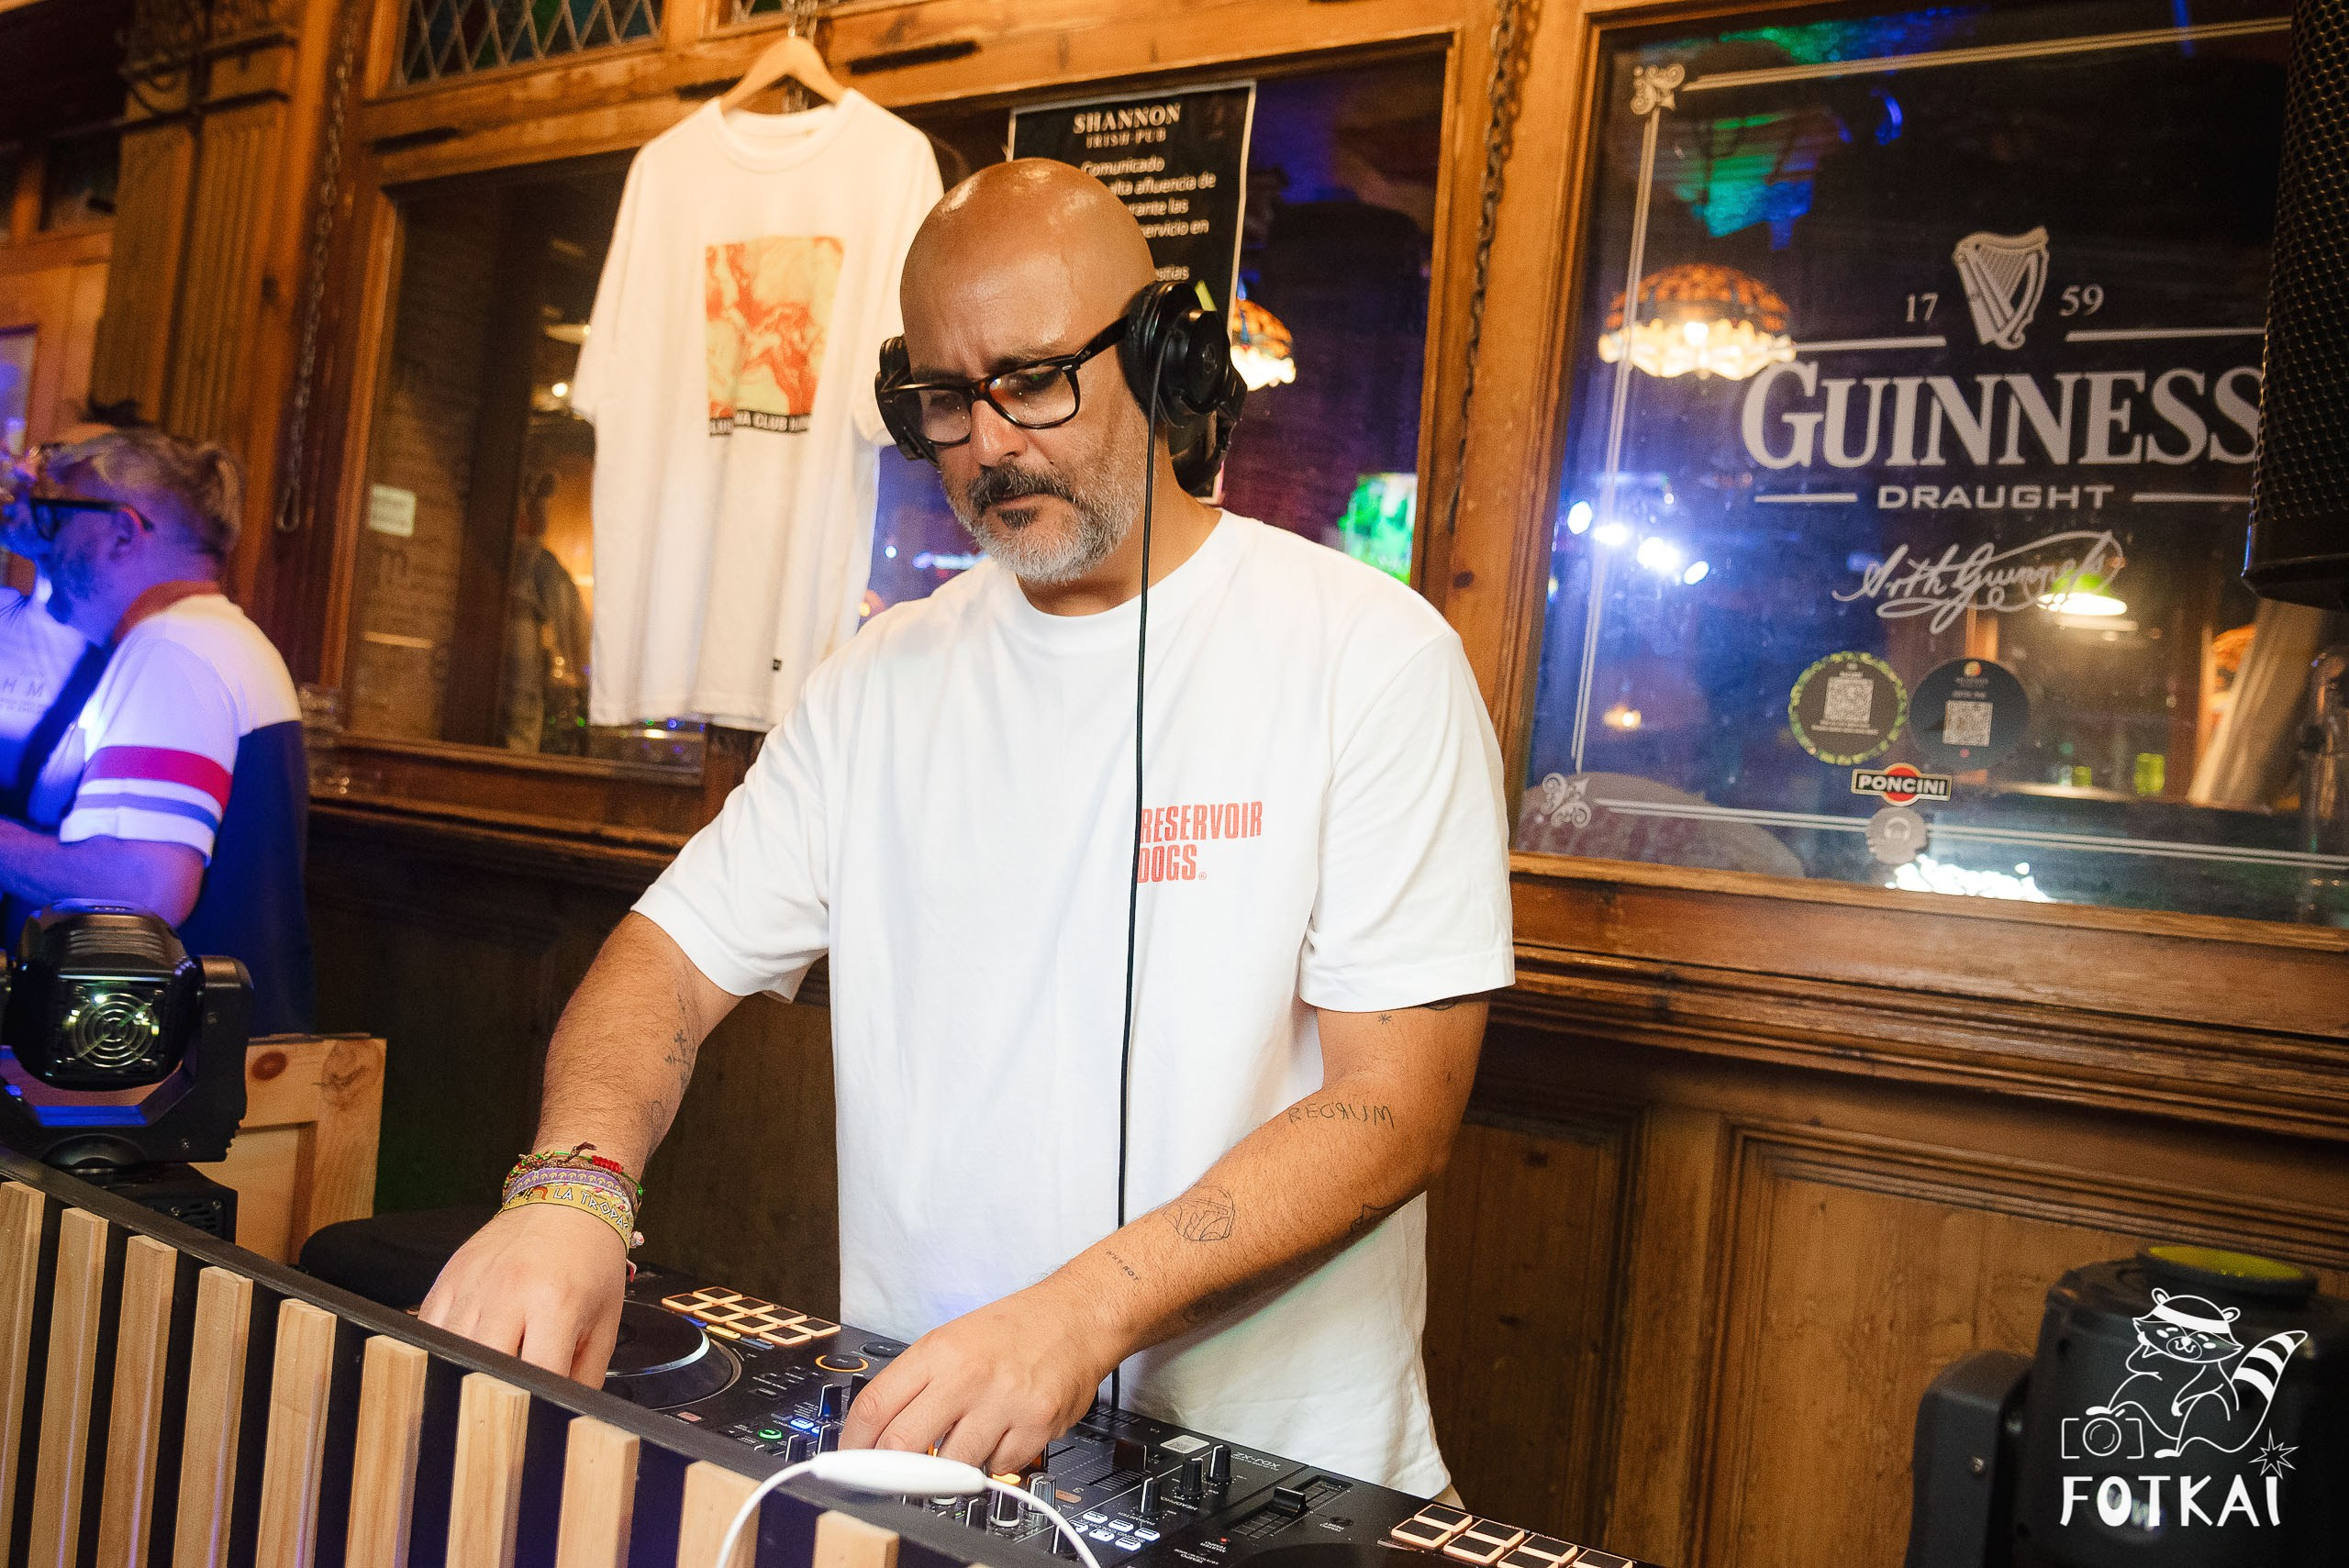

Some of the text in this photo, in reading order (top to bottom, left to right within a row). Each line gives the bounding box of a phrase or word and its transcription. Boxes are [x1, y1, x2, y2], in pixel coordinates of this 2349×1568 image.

[1073, 102, 1181, 134] SHANNON
[1085, 127, 1166, 149] IRISH PUB
[1134, 173, 1197, 195] afluencia
[1197, 171, 1217, 189] de
[1168, 196, 1189, 214] las
[1190, 219, 1209, 234] en
[1904, 284, 2104, 323] 17 59
[1743, 359, 2264, 470] GUINNESS
[1877, 485, 2114, 509] DRAUGHT
[1857, 773, 1946, 795] PONCINI
[1140, 801, 1263, 843] RESERVOIR
[1137, 844, 1197, 884] DOGS
[553, 1186, 573, 1202] LA
